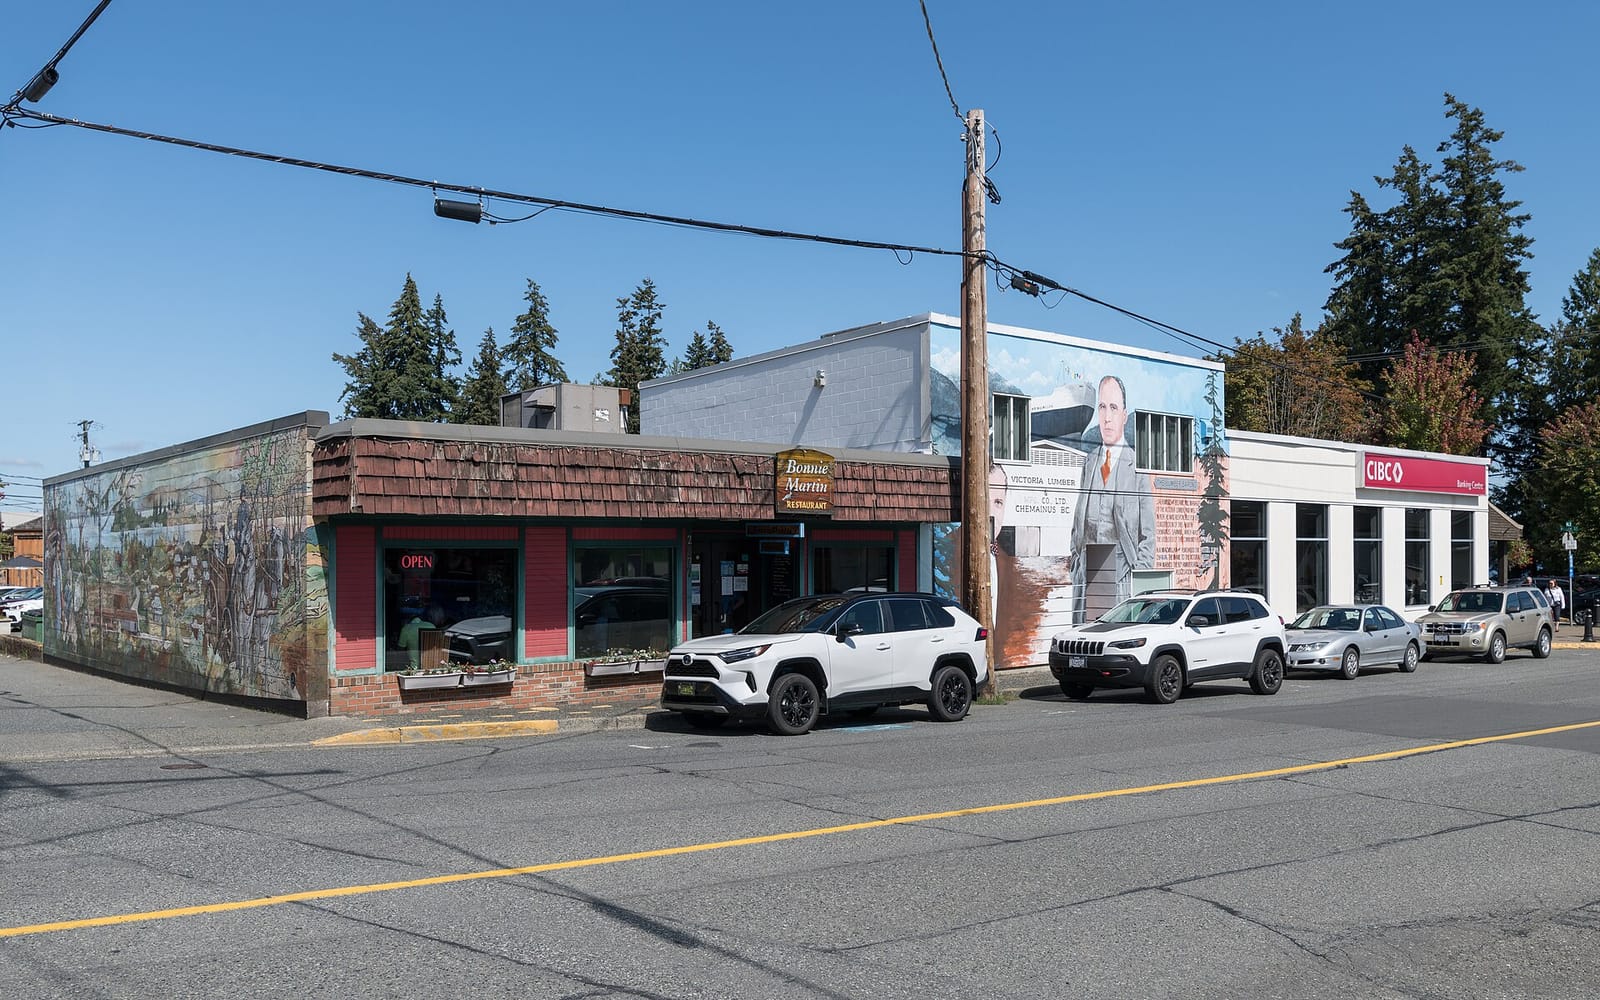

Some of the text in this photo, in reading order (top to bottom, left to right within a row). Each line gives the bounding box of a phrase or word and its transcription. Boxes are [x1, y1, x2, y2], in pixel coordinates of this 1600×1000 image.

[786, 459, 829, 475] Bonnie
[1366, 460, 1392, 482] CIBC
[785, 477, 828, 493] Martin
[1011, 475, 1076, 486] VICTORIA LUMBER
[1456, 480, 1472, 490] Banking
[786, 501, 828, 510] RESTAURANT
[1015, 504, 1057, 514] CHEMAINUS
[401, 555, 433, 569] OPEN
